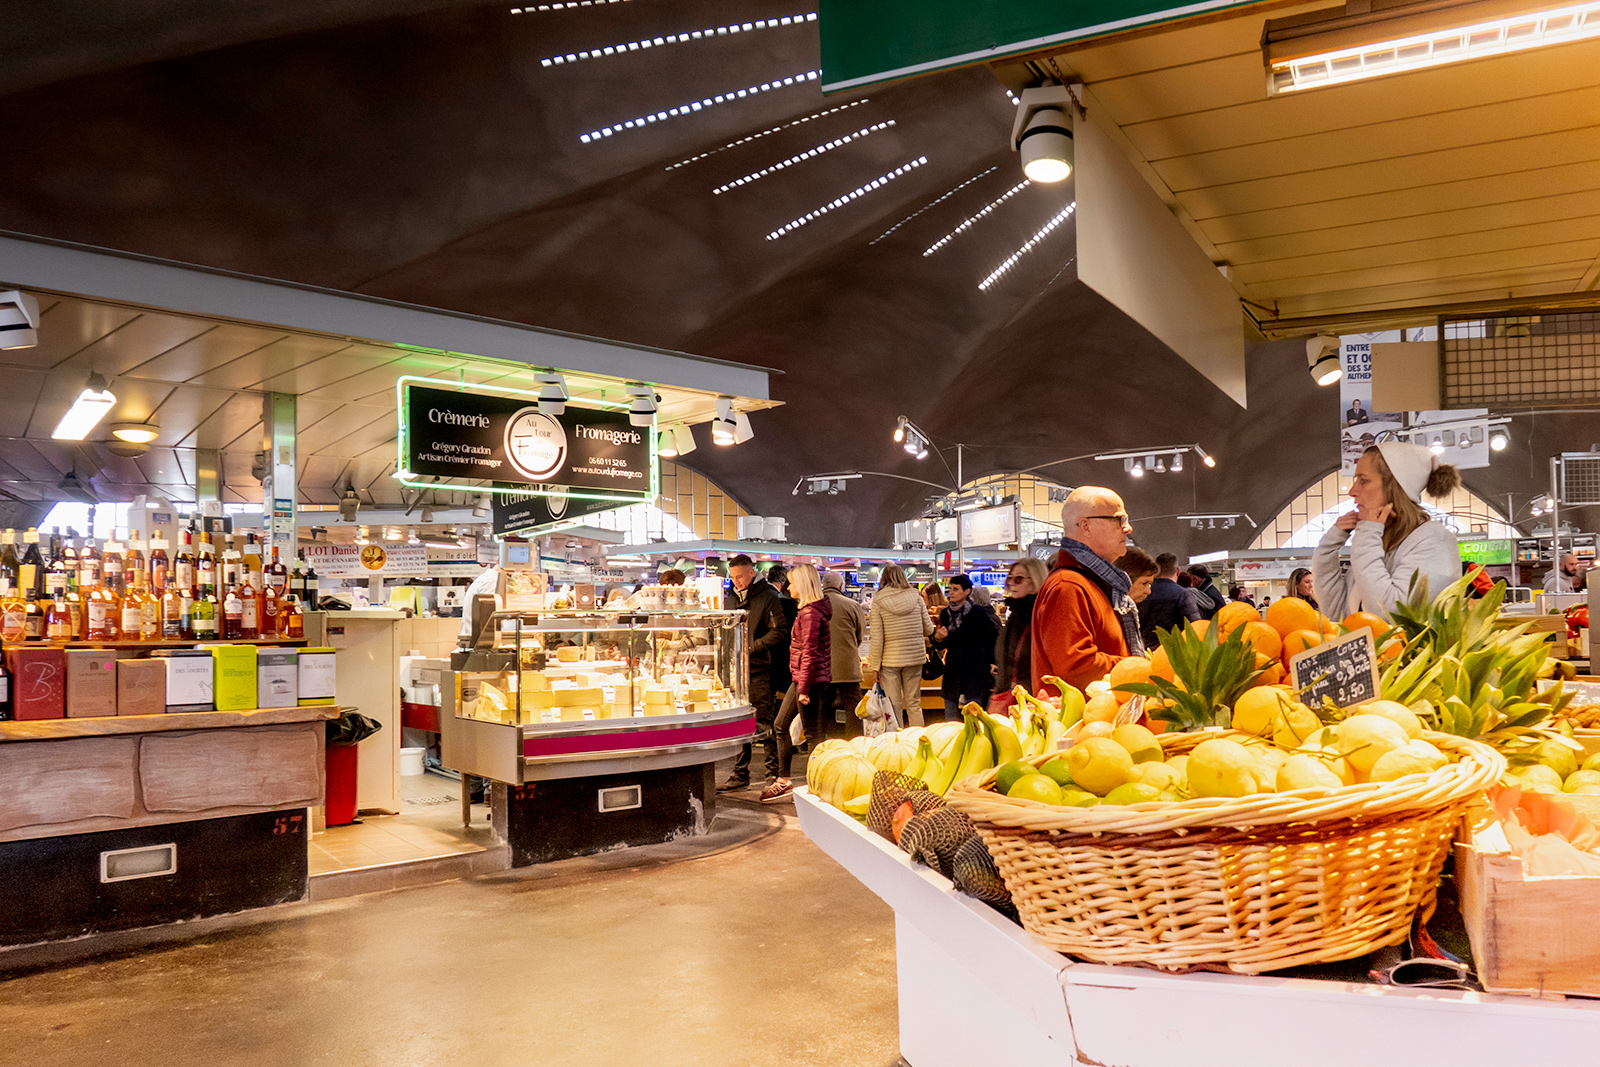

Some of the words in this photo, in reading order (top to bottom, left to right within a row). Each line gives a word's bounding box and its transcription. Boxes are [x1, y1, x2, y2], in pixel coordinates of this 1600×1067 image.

[1346, 344, 1370, 352] ENTRE
[1347, 354, 1358, 363] ET
[1347, 364, 1361, 372] DES
[428, 407, 490, 429] Crèmerie
[526, 418, 538, 428] Au
[535, 428, 553, 438] tour
[575, 423, 641, 446] Fromagerie
[432, 441, 461, 454] Grégory
[461, 444, 491, 455] Giraudon
[418, 452, 444, 462] Artisan
[444, 454, 470, 464] Crémier
[470, 456, 502, 468] Fromager
[605, 458, 611, 466] 11
[331, 545, 360, 556] Daniel
[1338, 681, 1365, 703] 2,50
[273, 815, 303, 835] 57
